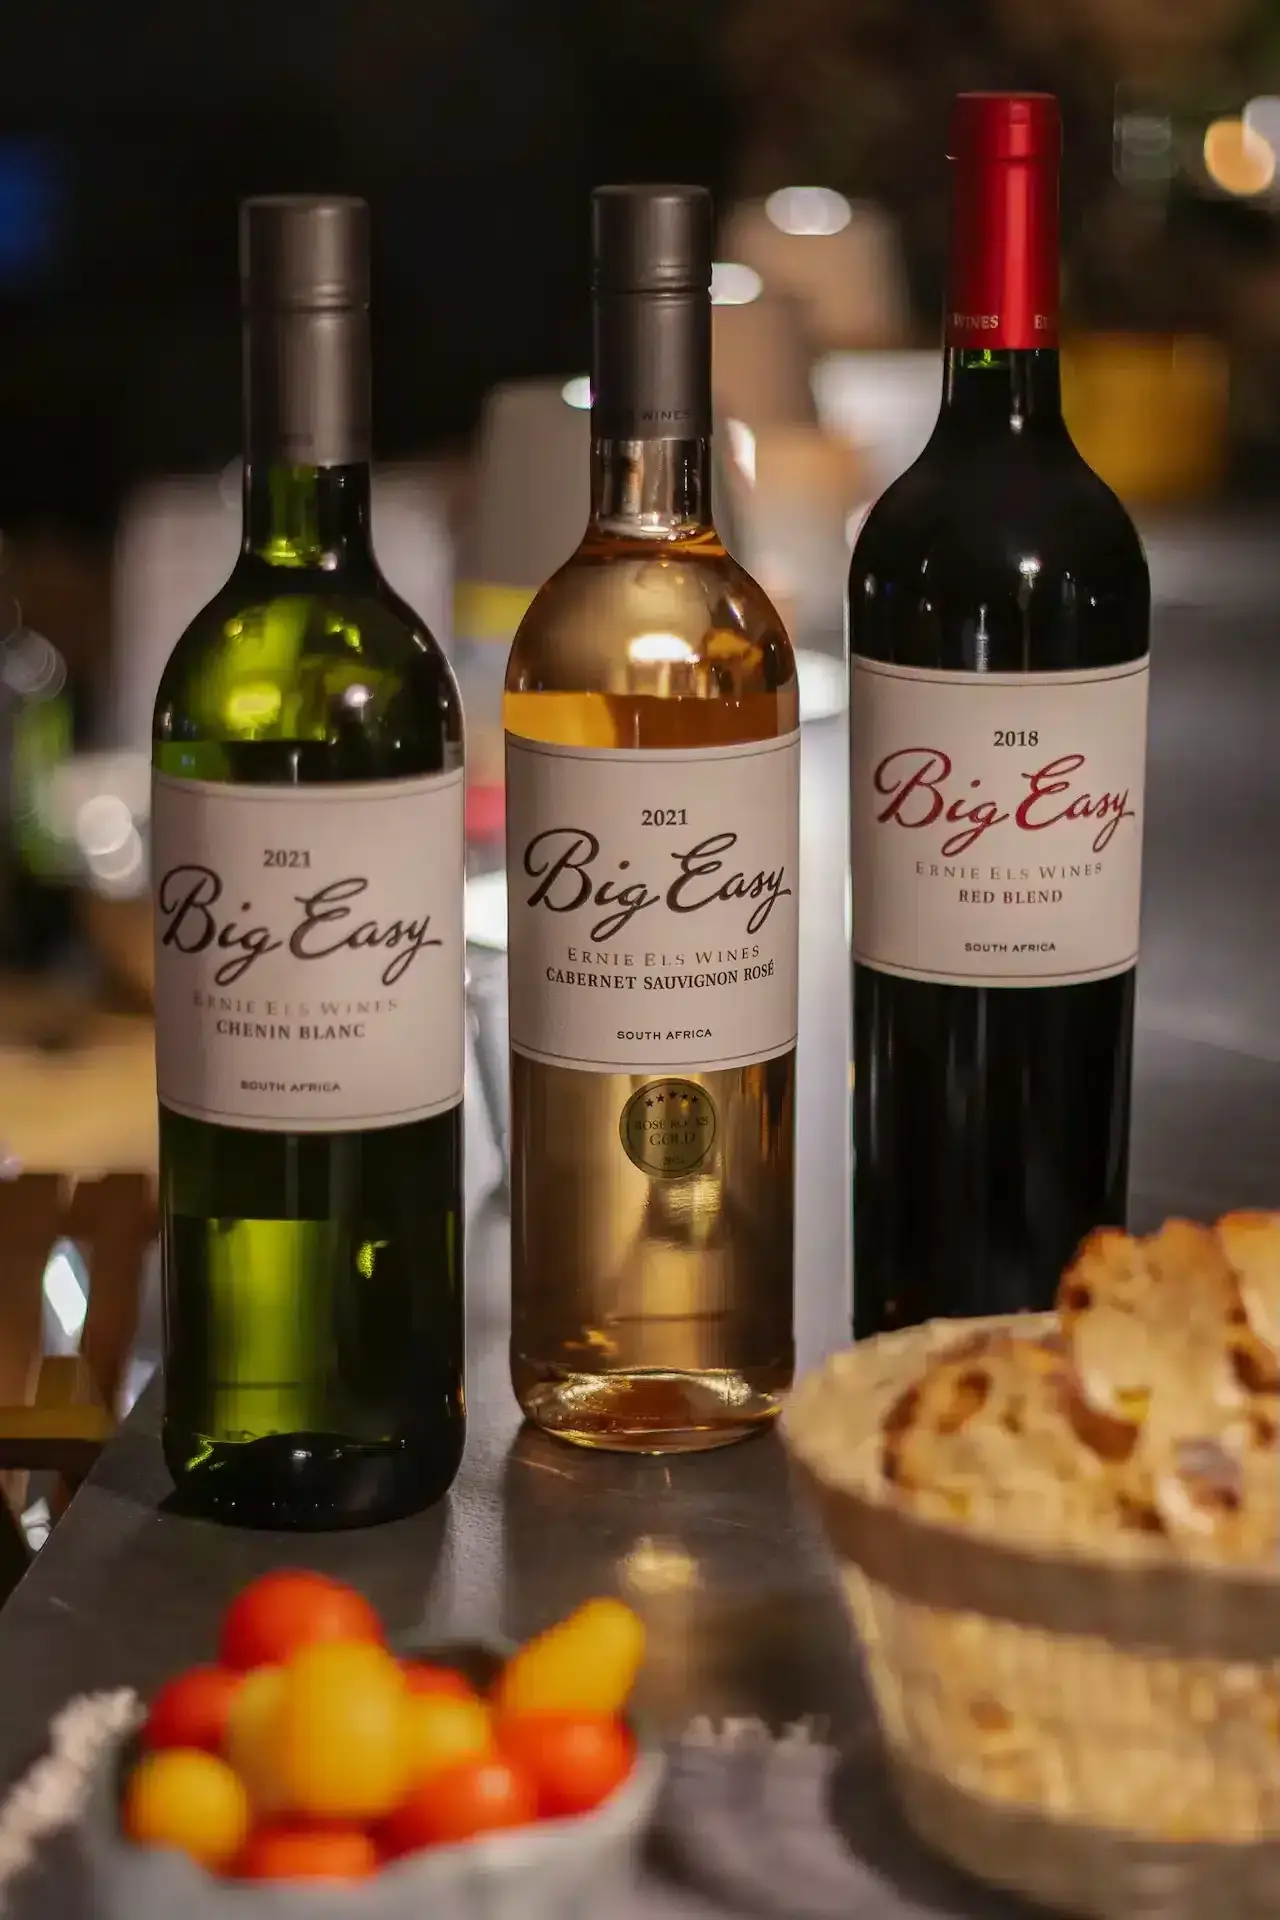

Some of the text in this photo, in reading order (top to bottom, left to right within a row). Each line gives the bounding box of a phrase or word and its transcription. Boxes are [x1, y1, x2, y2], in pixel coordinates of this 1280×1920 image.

[953, 312, 999, 330] WINES
[993, 730, 1039, 747] 2018
[873, 747, 1135, 857] Big Easy
[640, 808, 689, 827] 2021
[263, 849, 312, 868] 2021
[915, 861, 1103, 881] ERNIE ELS WINES
[523, 828, 792, 942] Big Easy
[958, 889, 1063, 904] RED BLEND
[158, 864, 443, 987] Big Easy
[567, 945, 760, 967] ERNIE ELS WINES
[964, 941, 1056, 953] SOUTH AFRICA
[546, 959, 775, 990] CABERNET SAUVIGNON ROSÉ
[193, 990, 256, 1015] ERNIE
[216, 1019, 366, 1040] CHENIN BLANC
[616, 1028, 713, 1041] SOUTH AFRICA
[240, 1079, 342, 1093] SOUTH AFRICA
[649, 1131, 696, 1146] GOLD
